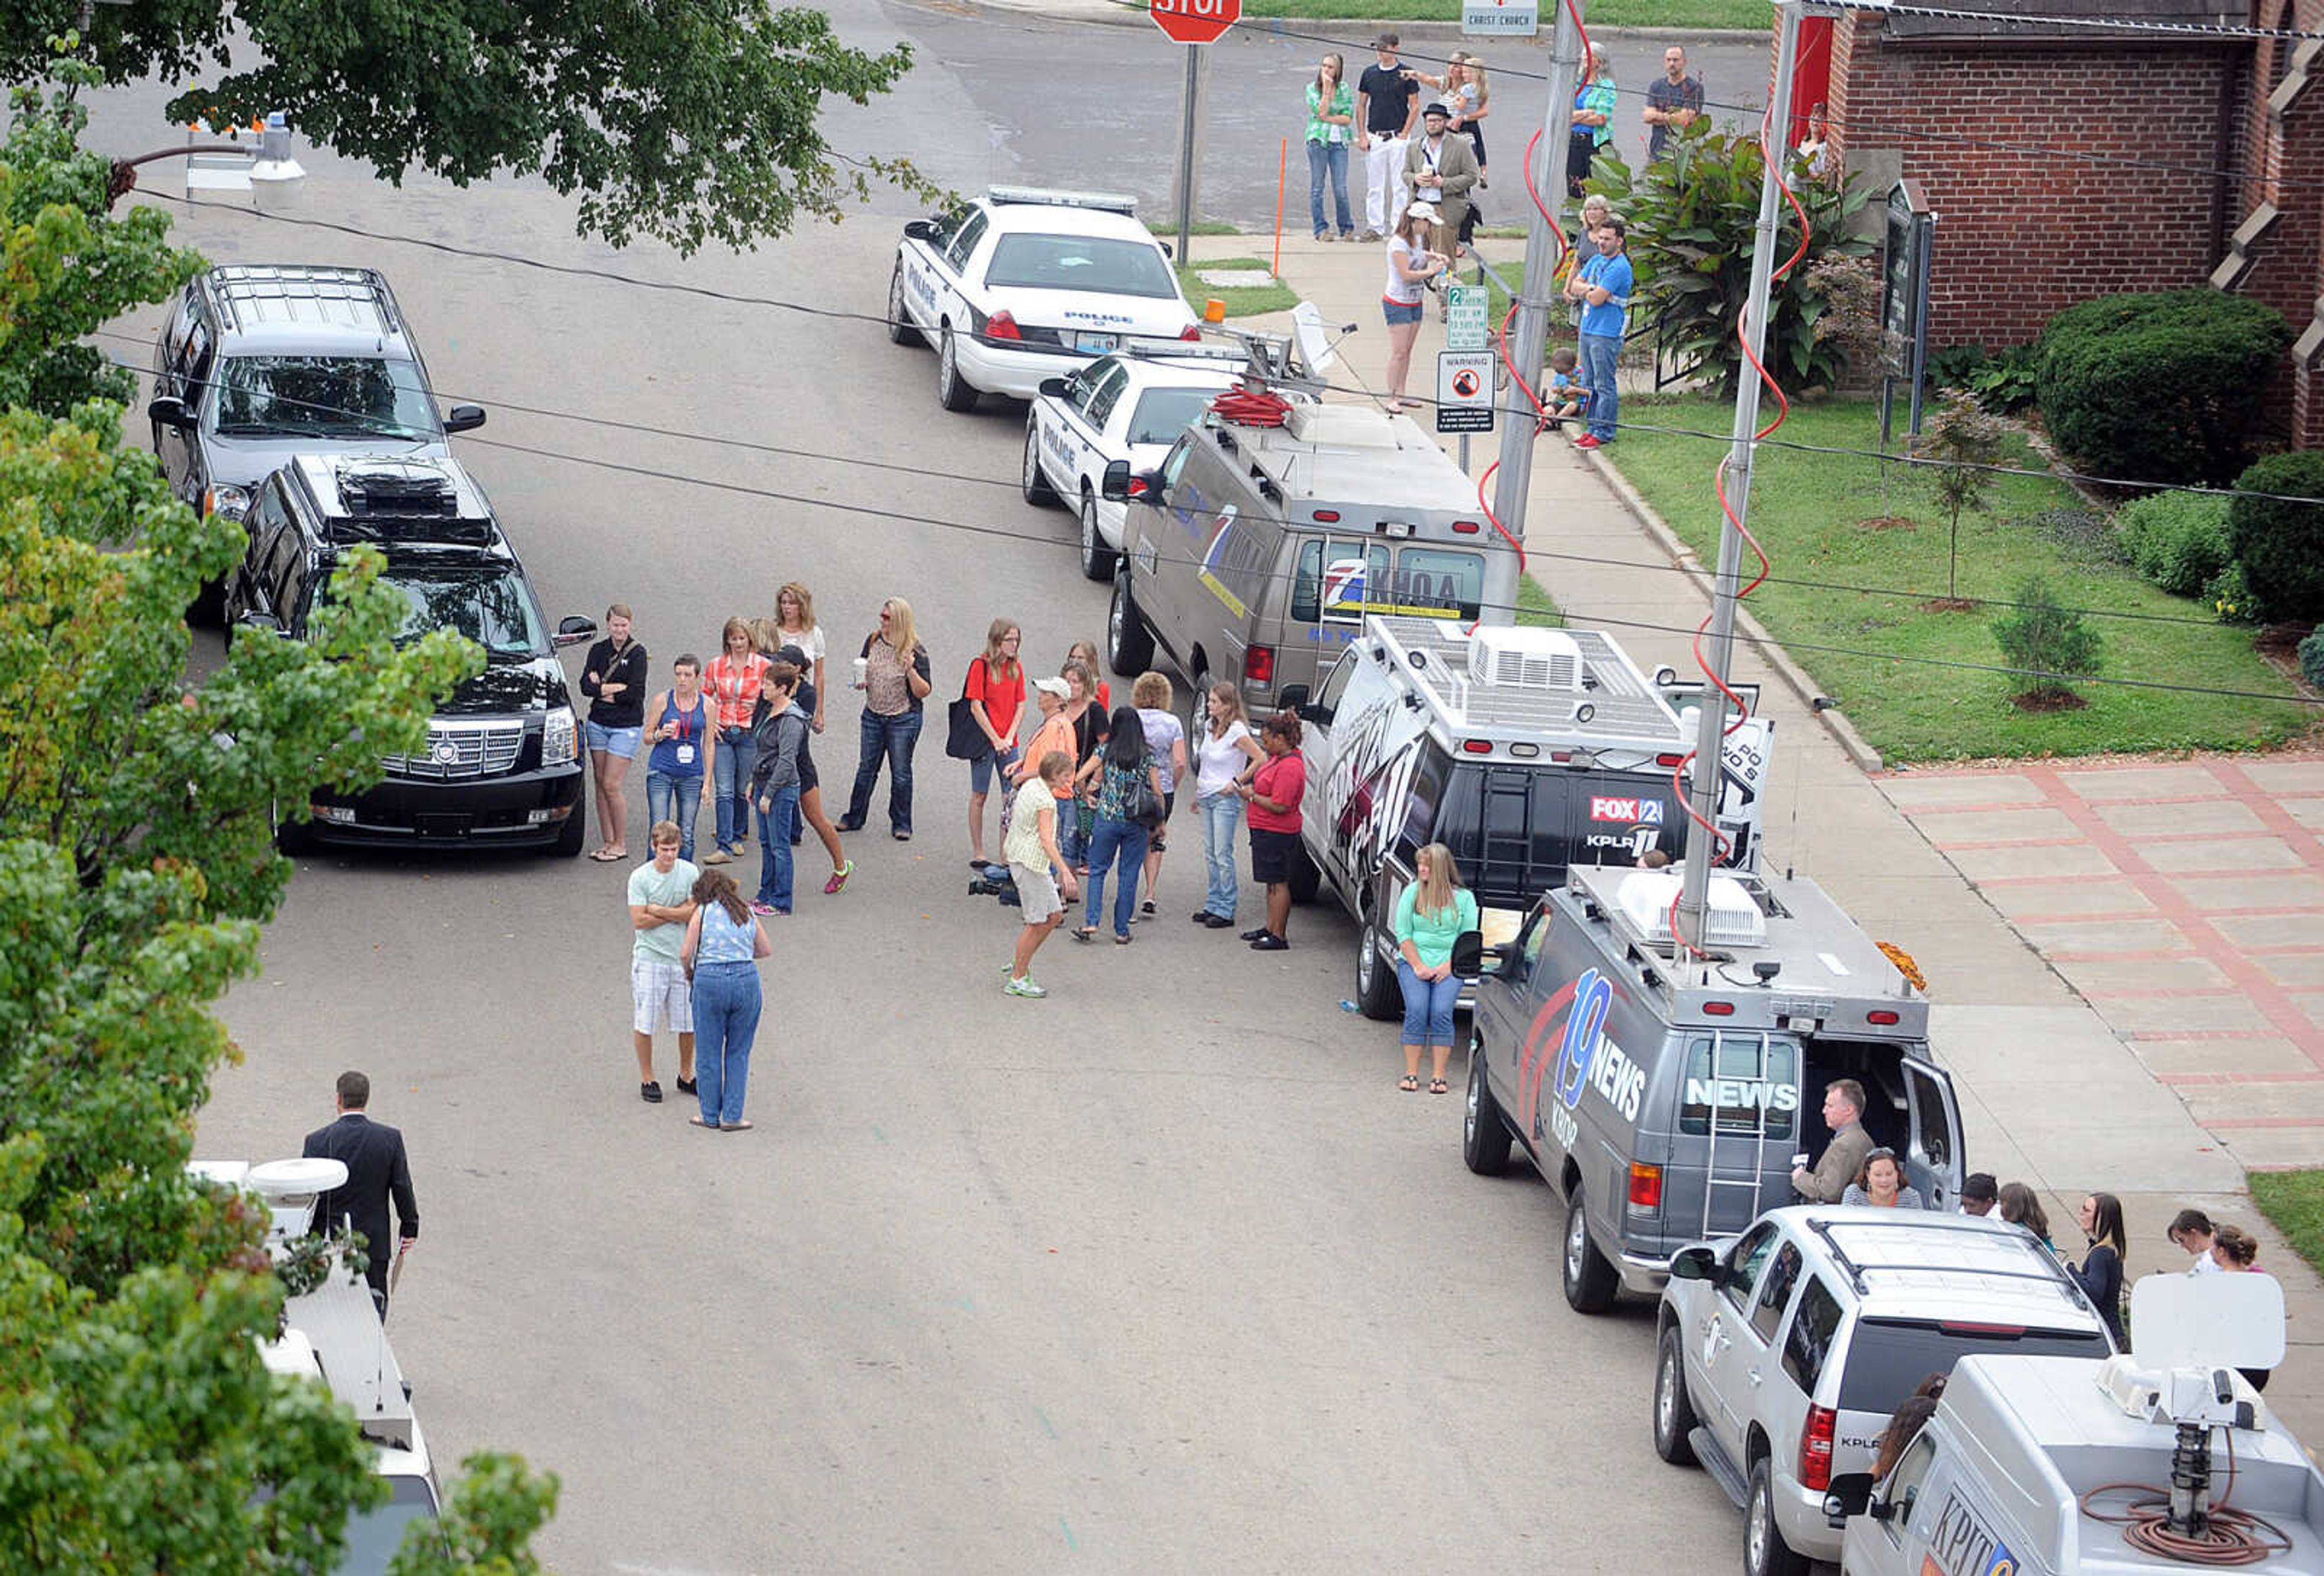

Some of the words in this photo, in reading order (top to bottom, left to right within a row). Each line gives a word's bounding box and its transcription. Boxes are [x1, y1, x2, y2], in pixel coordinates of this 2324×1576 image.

[1469, 16, 1495, 25] CHRIST
[1500, 16, 1529, 26] CHURCH
[908, 263, 936, 310] POLICE
[1452, 290, 1460, 304] 2
[1064, 312, 1133, 324] POLICE
[1043, 422, 1075, 472] POLICE
[1592, 798, 1636, 819] FOX
[1643, 801, 1659, 822] 2
[1587, 835, 1635, 849] KPLR
[1554, 967, 1613, 1111] 19
[1588, 1031, 1646, 1123] NEWS
[1687, 1078, 1798, 1111] NEWS
